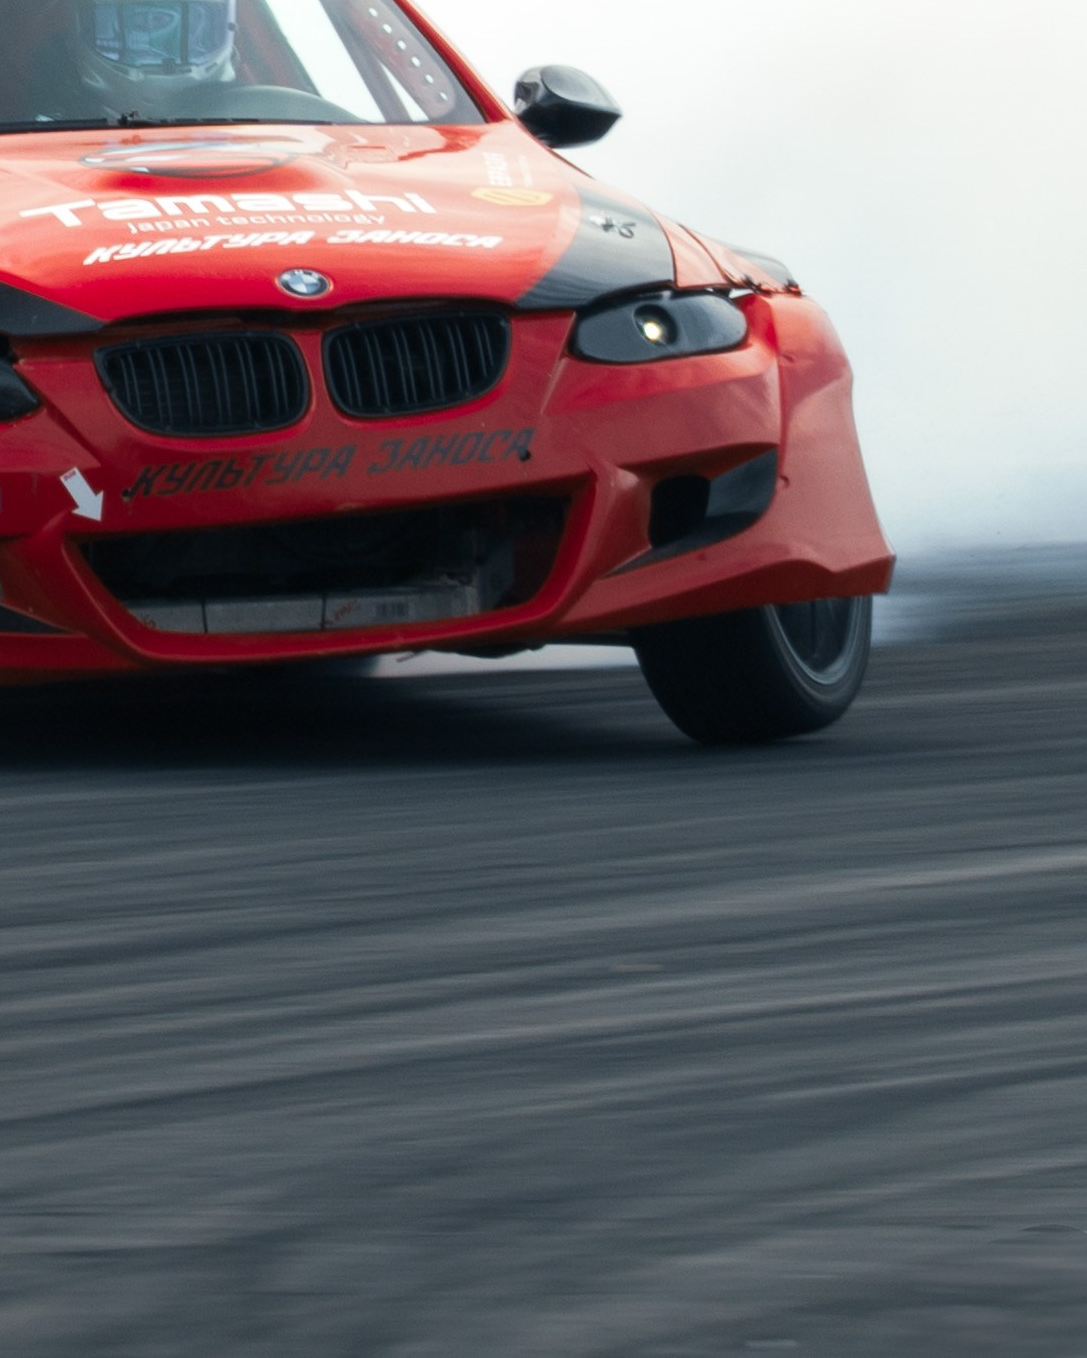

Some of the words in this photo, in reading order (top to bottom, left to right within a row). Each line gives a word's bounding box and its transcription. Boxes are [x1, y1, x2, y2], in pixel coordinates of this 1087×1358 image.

[19, 189, 438, 228] Tamashi
[215, 213, 386, 226] technology
[82, 230, 316, 266] КУЛЬТУРА
[326, 230, 504, 248] ЗАНОСА
[130, 445, 358, 498] КУЛЬТУРА
[366, 428, 536, 475] ЗАНОСА
